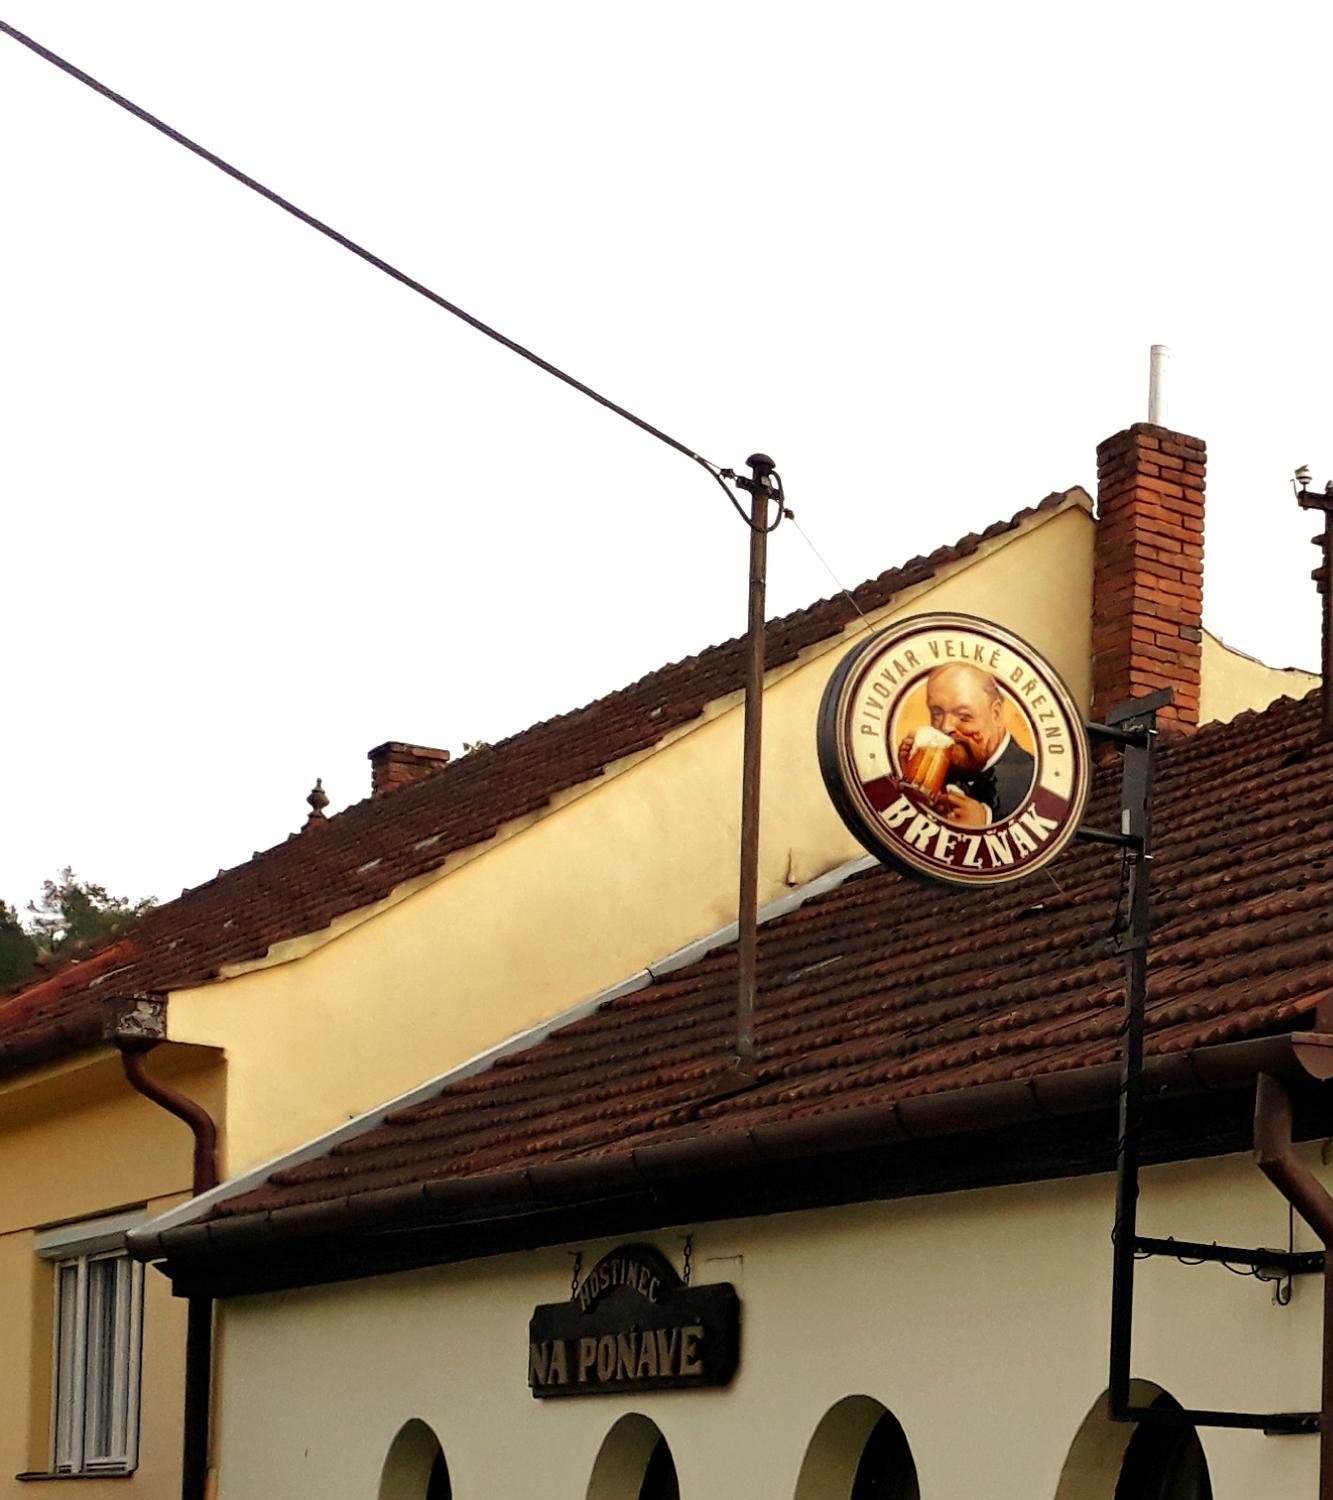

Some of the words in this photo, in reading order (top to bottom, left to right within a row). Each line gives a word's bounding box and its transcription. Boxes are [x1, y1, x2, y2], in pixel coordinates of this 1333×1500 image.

[861, 649, 920, 737] PIVOVAR
[928, 639, 1001, 669] VELKÉ
[1010, 667, 1065, 756] BŘEZNO
[879, 795, 1059, 871] BŘEZŇÁK
[577, 1258, 661, 1312] HOSTINEC
[529, 1339, 568, 1386] NA
